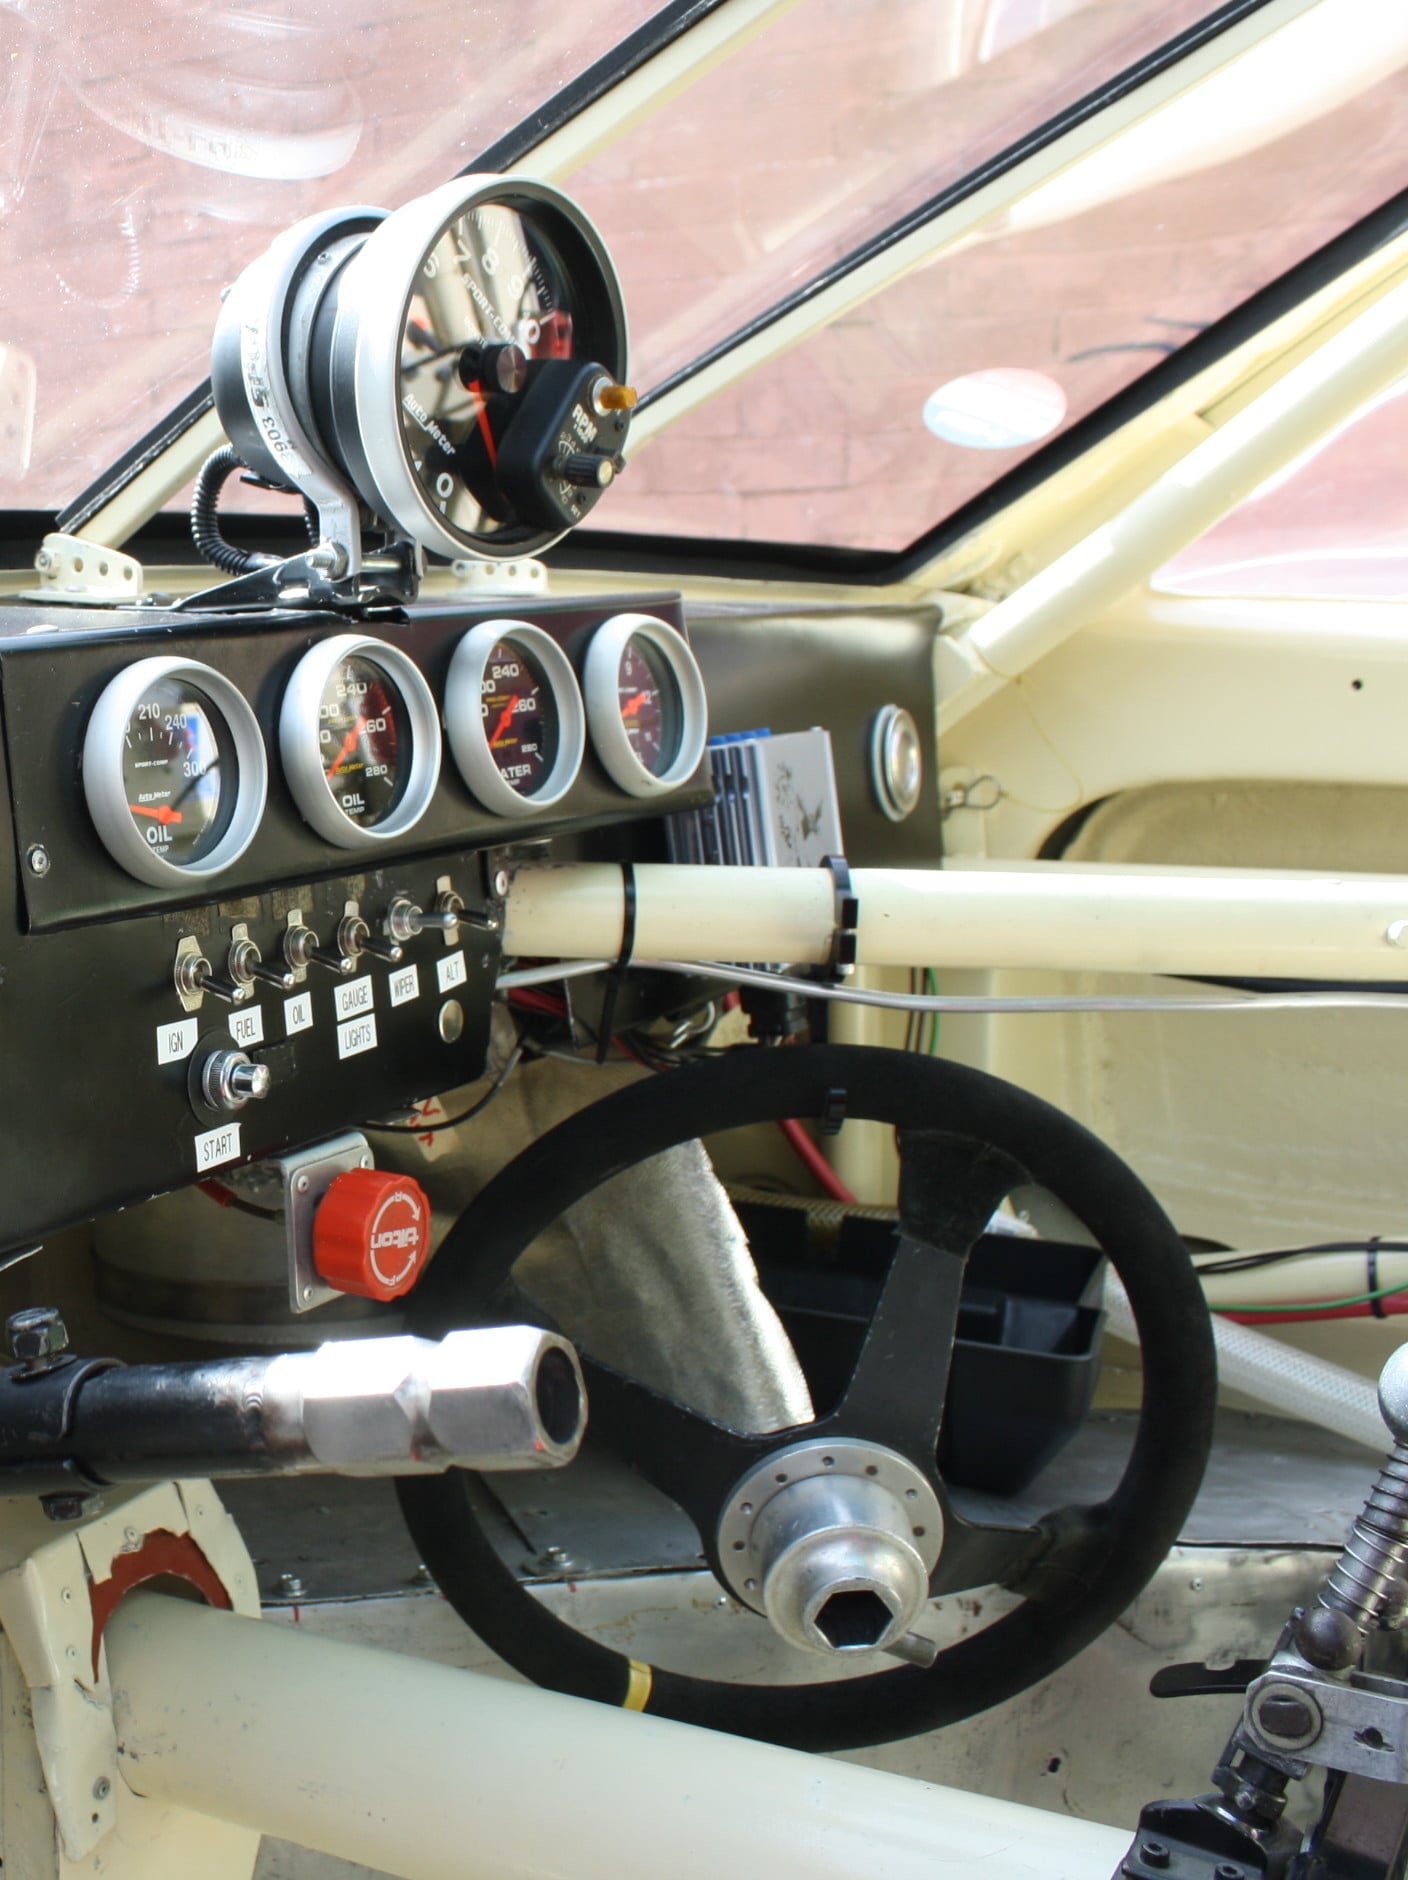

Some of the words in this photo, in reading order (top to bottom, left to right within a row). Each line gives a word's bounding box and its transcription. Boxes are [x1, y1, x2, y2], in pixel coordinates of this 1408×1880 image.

[481, 247, 499, 276] 8
[404, 392, 430, 430] Auto
[426, 415, 456, 456] Meter
[573, 403, 598, 442] RPM
[436, 472, 454, 498] 0
[492, 664, 519, 679] 240
[335, 682, 367, 697] 240
[138, 703, 161, 720] 210
[319, 703, 340, 719] 00
[164, 714, 188, 731] 240
[183, 761, 206, 777] 300
[365, 764, 388, 777] 280
[500, 763, 532, 779] ATER
[342, 793, 365, 808] OIL
[146, 825, 172, 843] OIL
[445, 960, 460, 982] ALT
[394, 973, 415, 998] WIPER
[342, 985, 369, 1012] GAUGE
[293, 1003, 306, 1025] OIL
[235, 1016, 256, 1041] FUEL
[344, 1024, 372, 1050] LIGHTS
[168, 1031, 184, 1054] IGN
[203, 1132, 233, 1162] START
[370, 1227, 419, 1249] tilton
